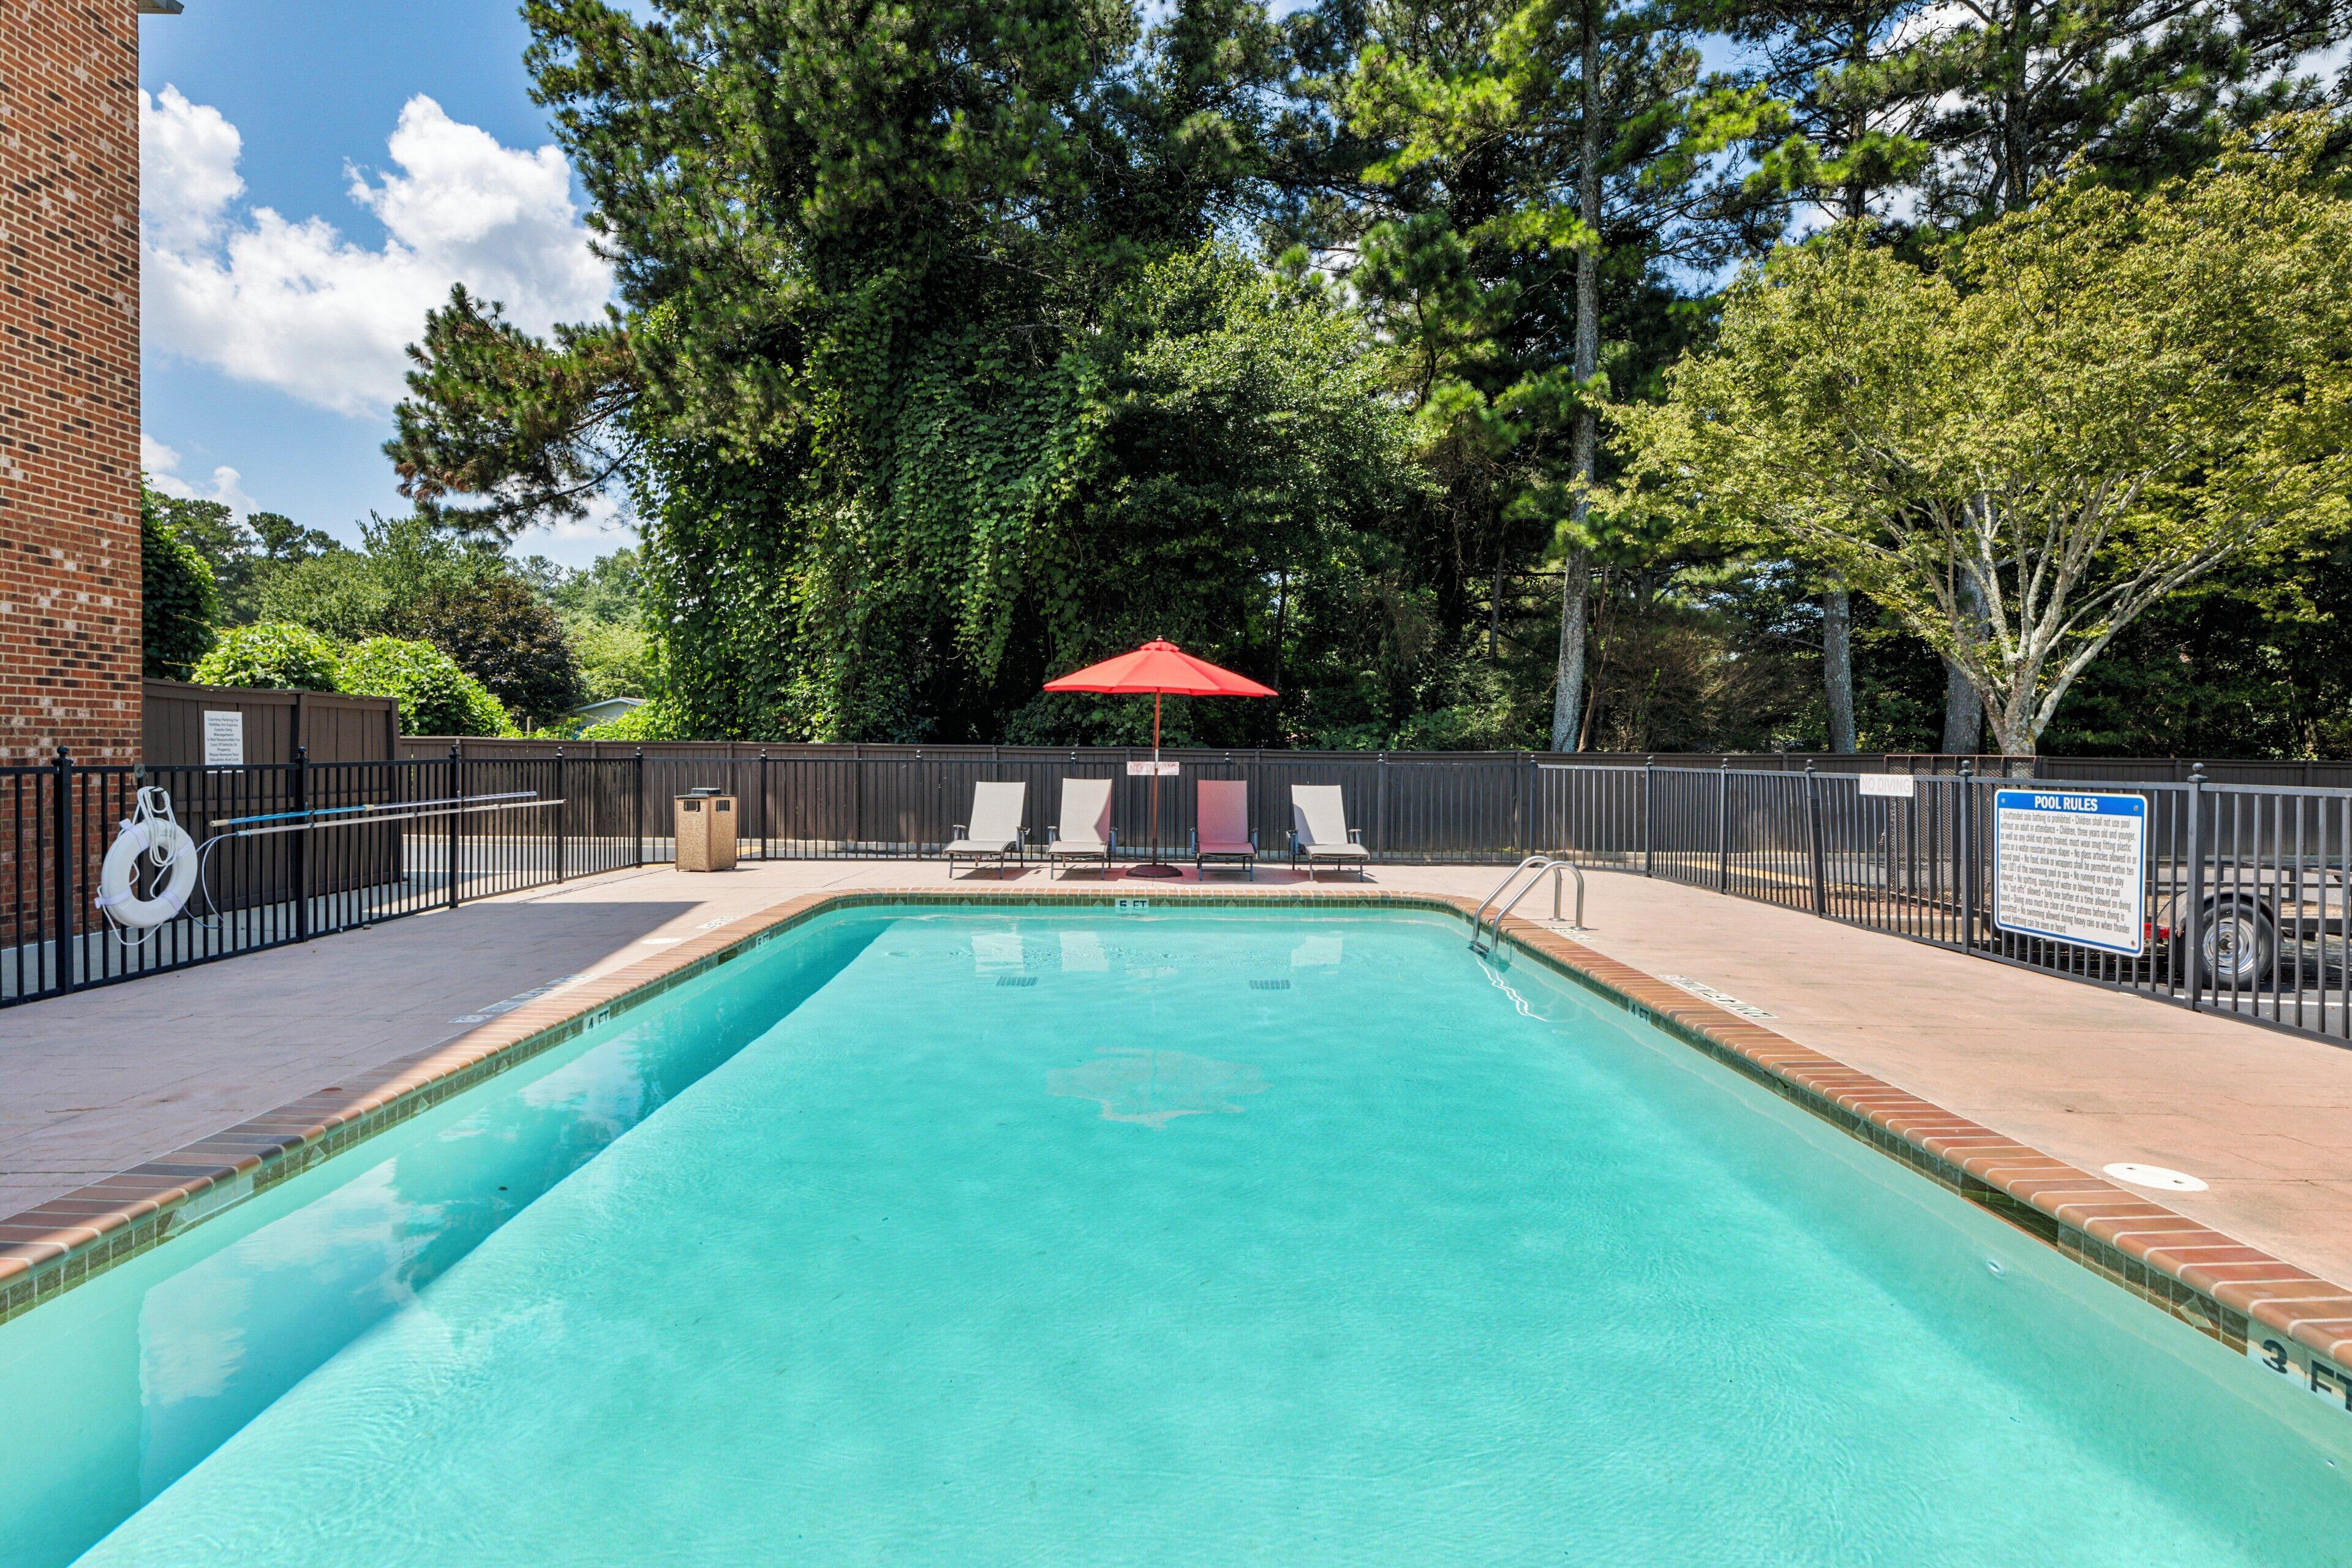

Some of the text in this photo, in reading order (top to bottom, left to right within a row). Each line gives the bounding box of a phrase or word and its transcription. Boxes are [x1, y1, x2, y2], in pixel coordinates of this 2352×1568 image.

[1130, 764, 1142, 772] NO
[1862, 777, 1910, 793] NO DIVING
[2035, 796, 2098, 812] POOL RULES
[2003, 811, 2022, 820] Unattended
[2032, 813, 2046, 824] bathing
[2046, 813, 2051, 823] is
[2051, 814, 2070, 824] prohibited
[2075, 815, 2091, 825] Children
[2092, 816, 2102, 826] shall
[2120, 818, 2130, 829] pool
[2000, 821, 2013, 830] without
[2020, 823, 2029, 831] adult
[2035, 824, 2055, 833] attendance
[2077, 827, 2087, 836] three
[2089, 829, 2100, 838] years
[2026, 833, 2035, 842] child
[2043, 835, 2052, 845] potty
[2091, 841, 2101, 851] snug
[2103, 840, 2116, 852] fitting
[2117, 842, 2131, 852] plastic
[2030, 845, 2046, 854] resistant
[2046, 846, 2057, 855] swim
[2058, 847, 2070, 858] diaper
[2074, 848, 2079, 858] No
[2081, 850, 2091, 860] glass
[2092, 851, 2108, 861] articles
[2109, 852, 2125, 862] allowed
[2024, 854, 2029, 862] No
[2040, 856, 2049, 865] drink
[2055, 860, 2073, 869] wrappers
[2073, 859, 2083, 869] shall
[2084, 861, 2089, 870] be
[2090, 863, 2111, 872] permitted
[2112, 865, 2125, 874] within
[2000, 872, 2013, 881] allowed
[2017, 873, 2022, 883] No
[2038, 879, 2054, 889] spouting
[2060, 881, 2071, 891] water
[2078, 882, 2094, 895] blowing
[2094, 886, 2105, 895] nose
[2111, 888, 2120, 898] pool
[2029, 866, 2047, 877] swimming
[2073, 870, 2079, 880] No
[2080, 873, 2095, 884] running
[2101, 875, 2114, 886] rough
[2115, 876, 2124, 888] play
[2003, 882, 2008, 891] No
[2027, 886, 2040, 896] allowed
[2061, 891, 2074, 901] bather
[2084, 895, 2094, 905] time
[2094, 896, 2111, 907] allowed
[2118, 900, 2131, 912] diving
[2000, 892, 2010, 902] board
[2013, 894, 2024, 905] Diving
[2044, 899, 2049, 908] be
[2049, 900, 2059, 910] clear
[2065, 903, 2075, 913] other
[2076, 905, 2091, 915] patrons
[2092, 907, 2106, 918] before
[2107, 909, 2119, 922] diving
[2000, 904, 2016, 913] permitted
[2021, 905, 2026, 914] No
[2026, 908, 2045, 919] swimming
[2046, 910, 2060, 921] allowed
[2061, 913, 2073, 924] during
[2074, 915, 2086, 927] heavy
[2101, 920, 2112, 930] when
[2114, 922, 2130, 933] thunder
[2011, 914, 2026, 926] lightning
[2035, 919, 2040, 928] be
[2040, 919, 2049, 929] seen
[598, 1010, 608, 1025] FT
[1640, 1008, 1649, 1022] FT
[2263, 1339, 2352, 1412] 3 FT
